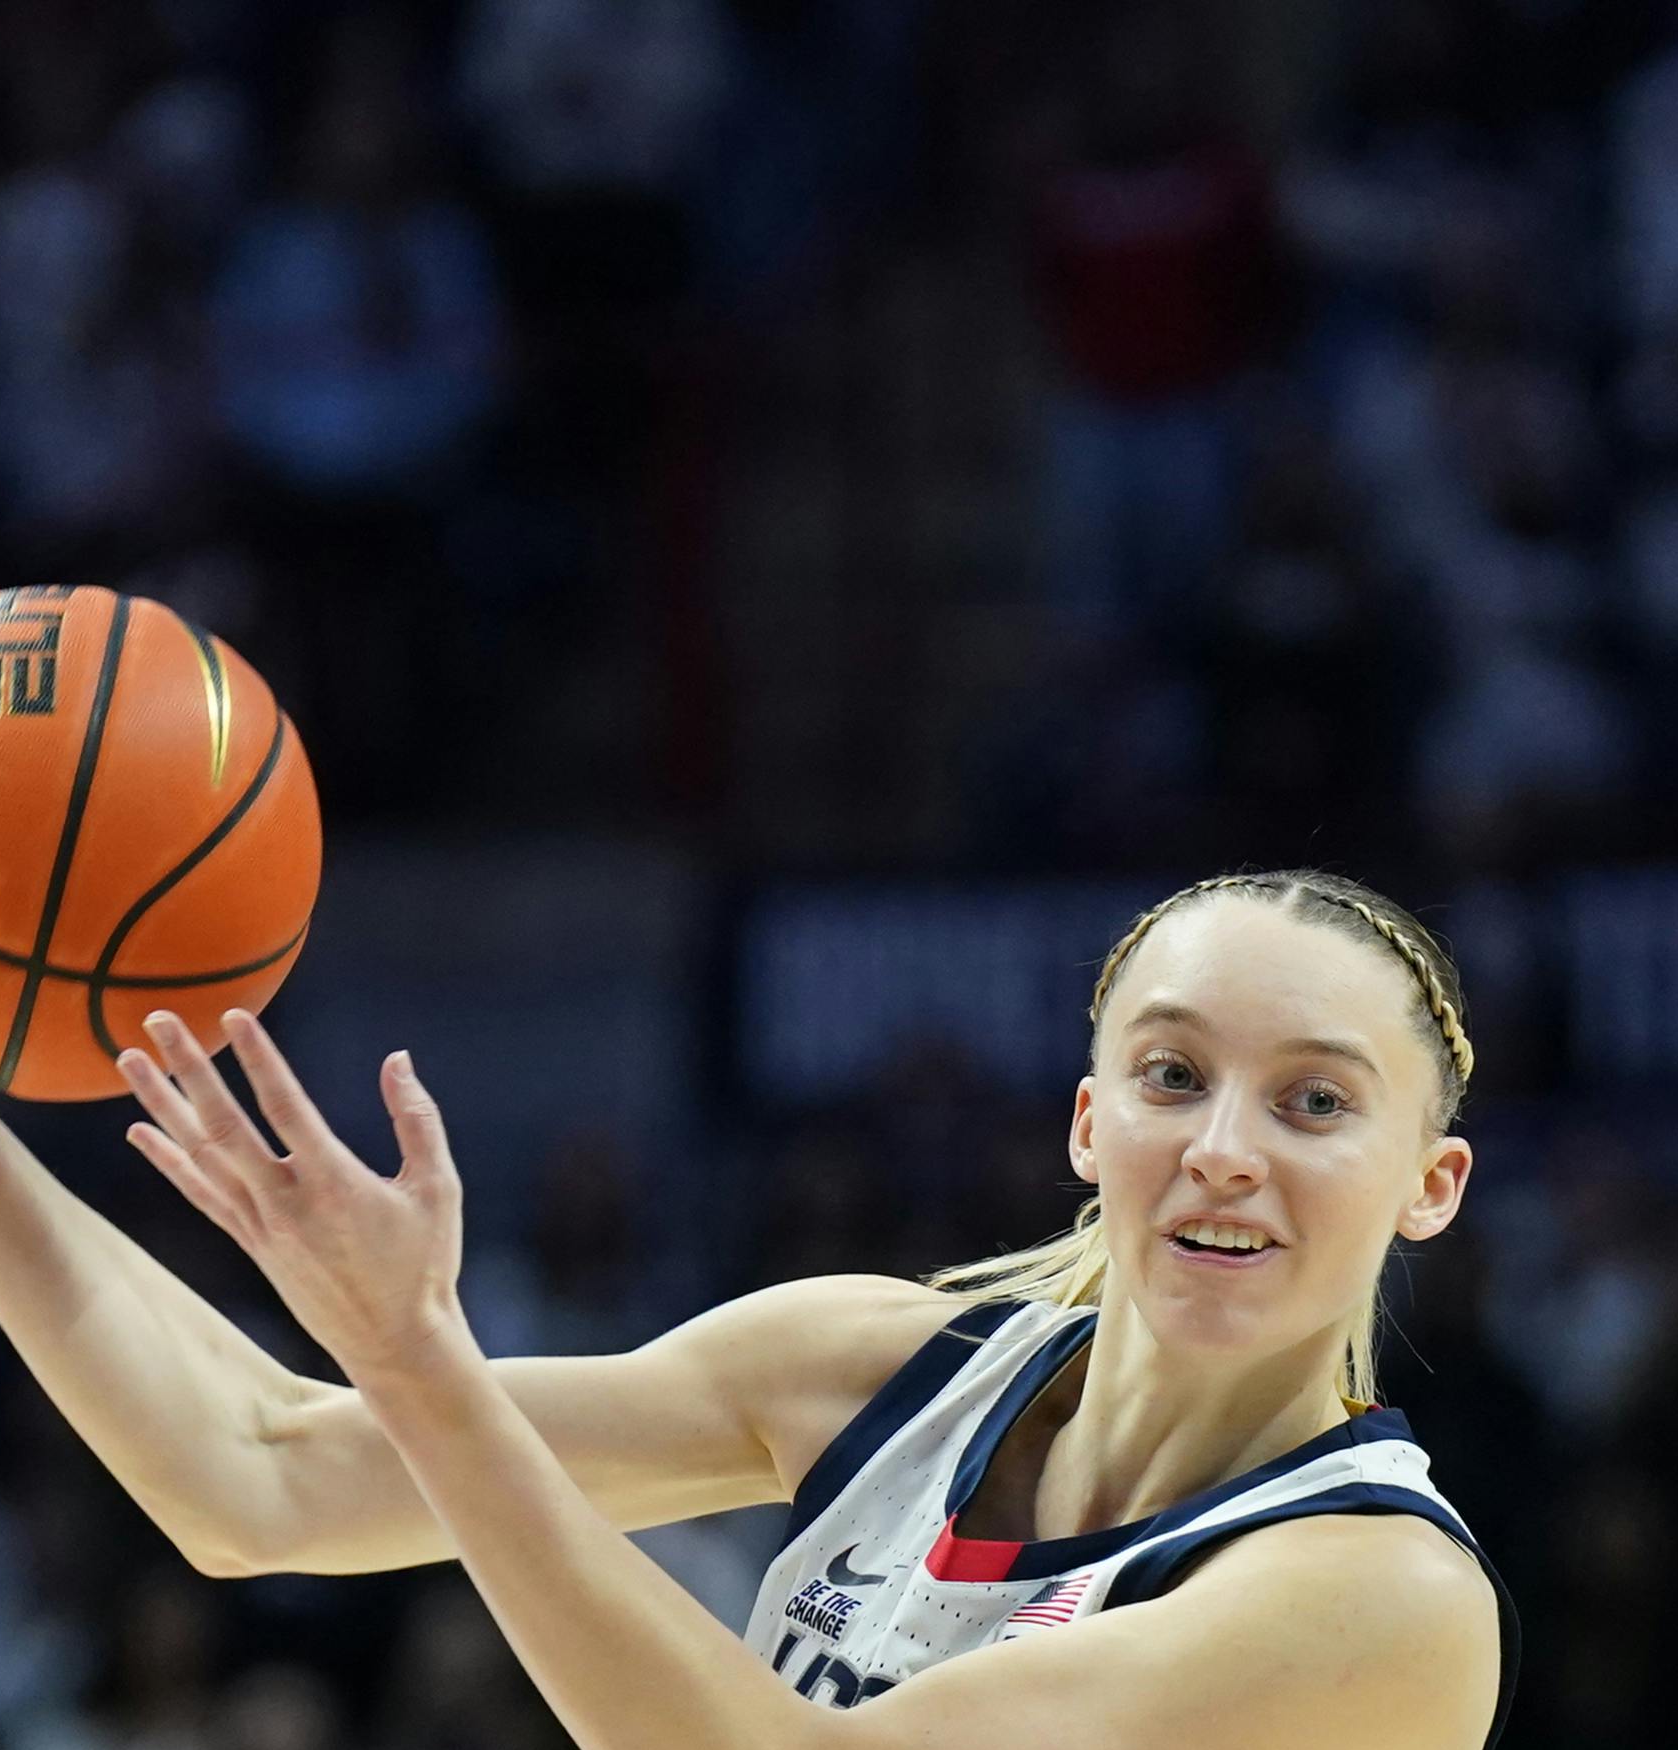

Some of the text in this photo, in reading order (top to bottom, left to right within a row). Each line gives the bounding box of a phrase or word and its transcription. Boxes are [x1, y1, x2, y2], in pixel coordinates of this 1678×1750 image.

[784, 1595, 848, 1642] CHANGE
[800, 1578, 863, 1617] BE THE
